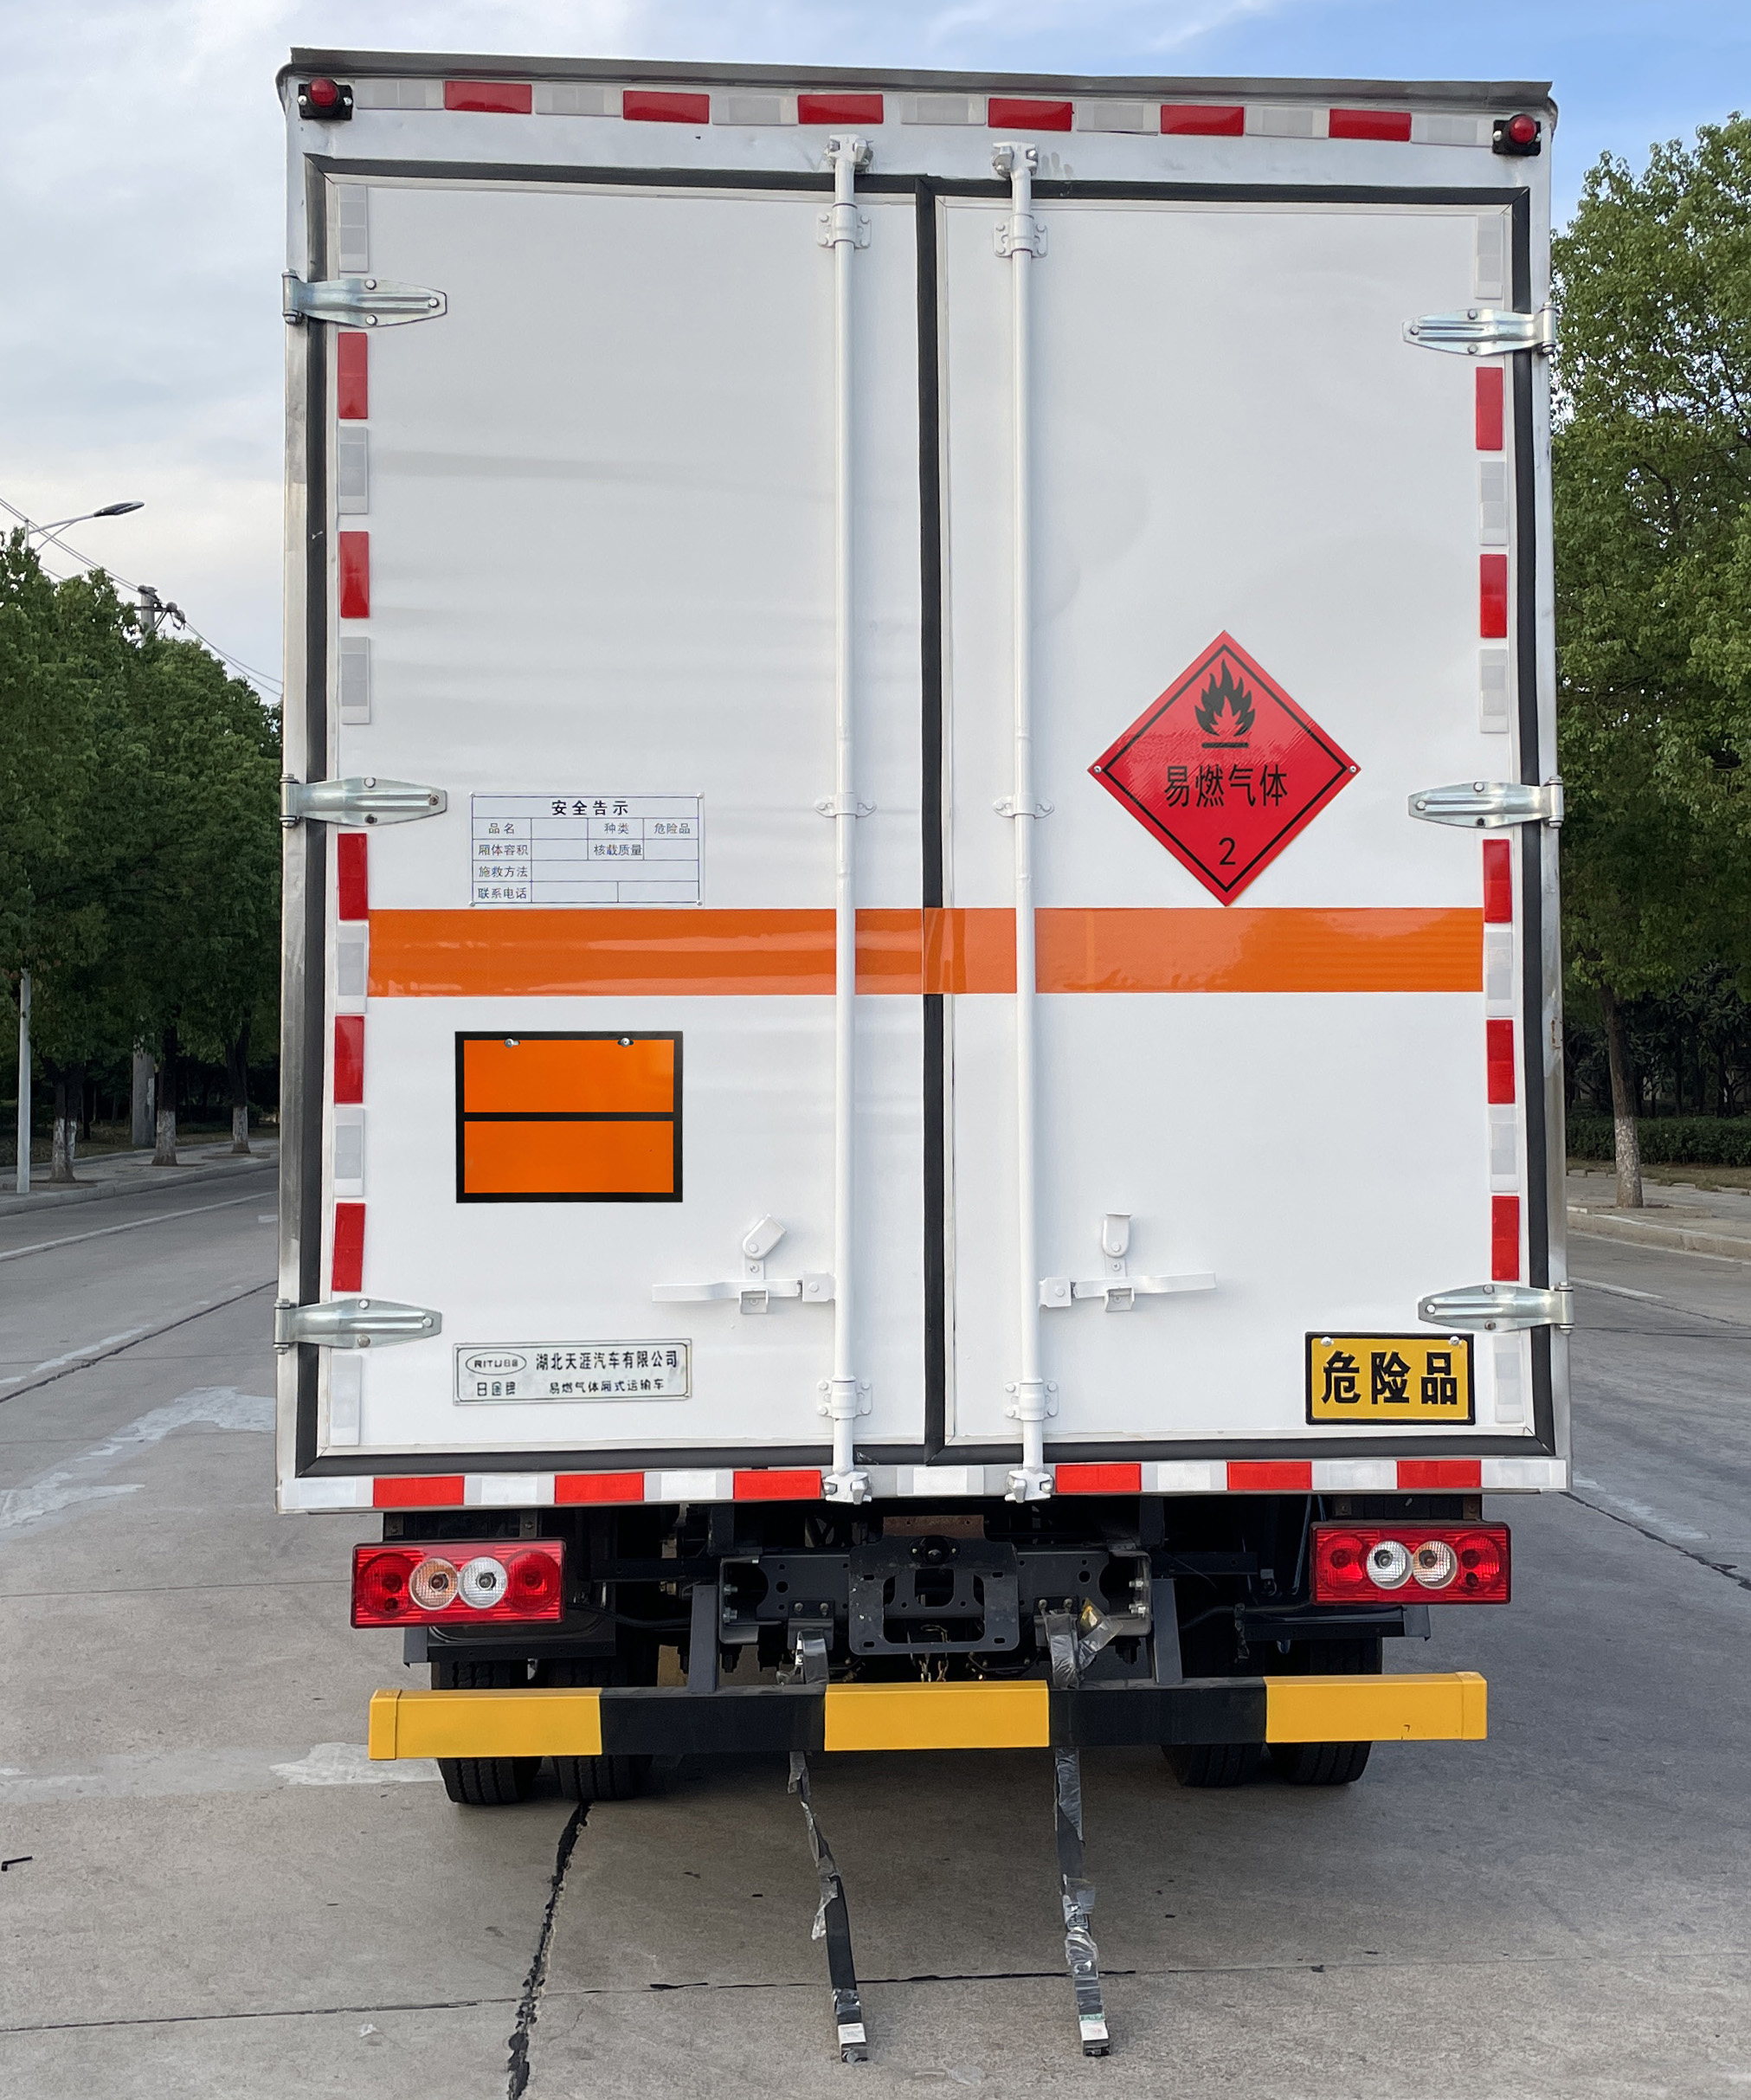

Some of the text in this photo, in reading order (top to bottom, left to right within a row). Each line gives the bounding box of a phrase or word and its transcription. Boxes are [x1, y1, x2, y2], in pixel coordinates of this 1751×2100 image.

[1164, 763, 1288, 808] 易燃气体
[551, 800, 628, 816] 安全告示
[488, 822, 515, 834] 品名
[604, 822, 629, 834] 种类
[653, 822, 691, 834] 危险品
[594, 844, 642, 856] 核载质量
[1218, 836, 1236, 866] 2
[478, 887, 527, 899] 联系电话
[536, 1350, 678, 1370] 湖北天涯汽车有限公司
[1321, 1350, 1458, 1405] 危险品
